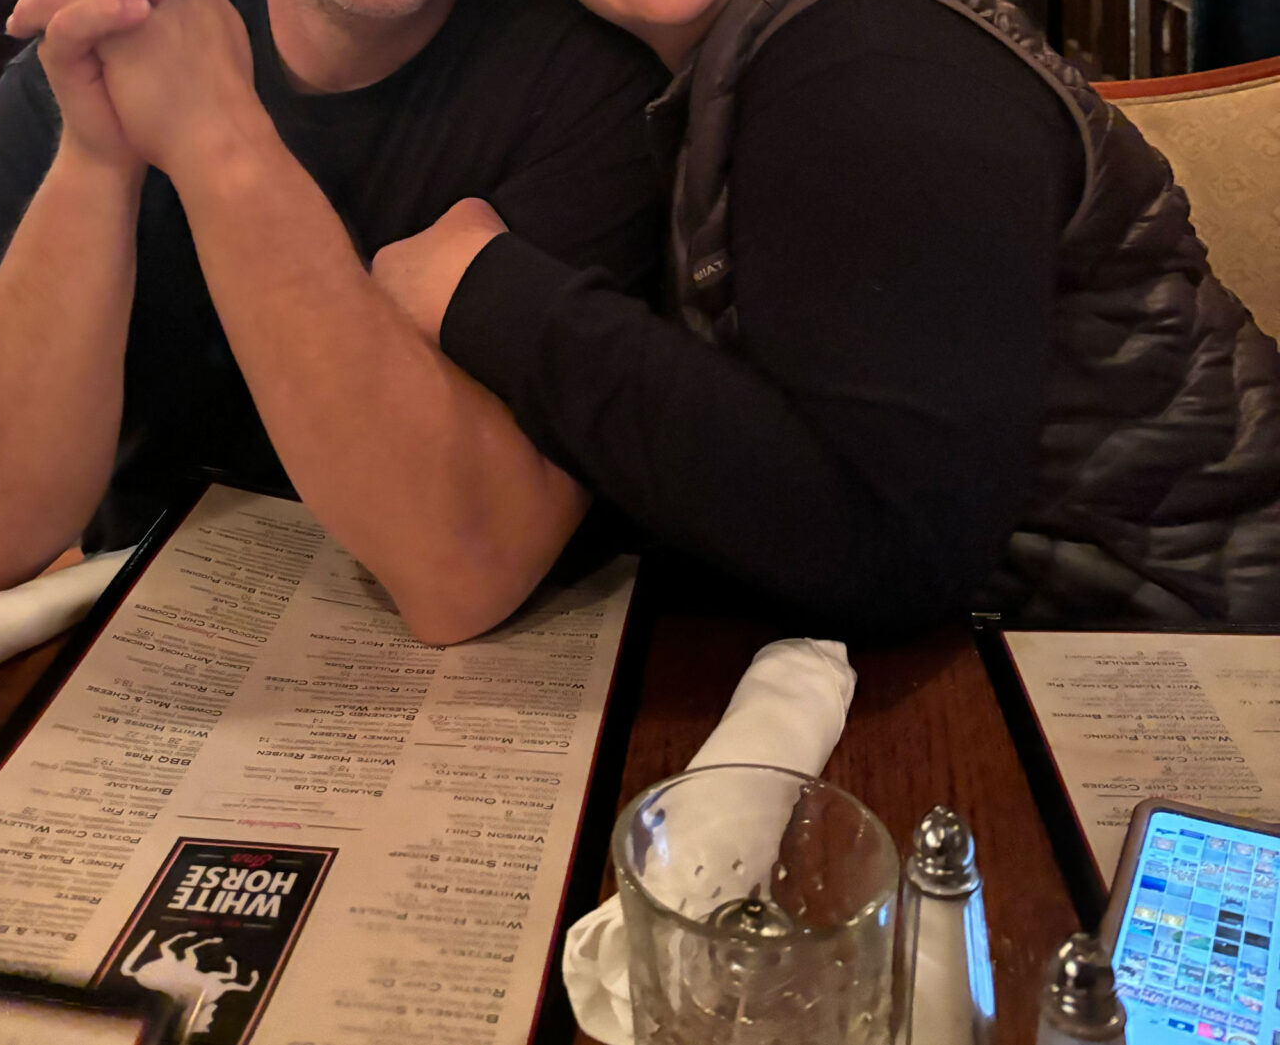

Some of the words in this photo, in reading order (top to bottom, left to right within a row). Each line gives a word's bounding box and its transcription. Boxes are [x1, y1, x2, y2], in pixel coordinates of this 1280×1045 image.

[179, 568, 221, 584] PUDDING
[223, 580, 256, 595] BREAD
[211, 596, 239, 608] CAKE
[259, 590, 290, 603] WARM
[133, 603, 177, 619] COOKIES
[241, 605, 281, 620] CARROT
[180, 615, 205, 627] CHIP
[209, 622, 267, 643] CHOCOLATE
[112, 634, 156, 650] CHICKEN
[310, 633, 357, 645] CHICKEN
[363, 640, 384, 648] HOT
[157, 646, 212, 665] ARTICHOKE
[214, 660, 250, 672] LEMON
[324, 662, 354, 670] PORK
[357, 664, 400, 674] PULLED
[264, 675, 308, 686] CHEESE
[442, 675, 493, 684] CHICKEN
[548, 680, 585, 690] WARM
[170, 680, 208, 693] ROAST
[312, 681, 358, 690] GRILLED
[362, 684, 400, 693] ROAST
[85, 684, 130, 701] CHEESE
[211, 686, 235, 697] POT
[133, 695, 142, 703] &
[145, 698, 171, 709] MAC
[173, 704, 223, 717] COWBOY
[294, 707, 344, 717] CHICKEN
[333, 703, 369, 711] WRAP
[374, 705, 419, 714] CAESAR
[91, 713, 119, 724] MAC
[349, 711, 416, 721] BLACKENED
[517, 710, 577, 720] ORCHARD
[123, 719, 165, 732] HORSE
[169, 726, 209, 739] WHITE
[309, 731, 357, 740] REUBEN
[1083, 733, 1139, 741] PUDDING
[1143, 734, 1186, 742] BREAD
[361, 734, 405, 743] TURKEY
[460, 734, 514, 744] MAURICE
[520, 738, 570, 748] CLASSIC
[1191, 734, 1233, 743] WARM
[124, 751, 153, 761] RIBS
[256, 749, 305, 760] REUBEN
[310, 753, 351, 764] HORSE
[1153, 755, 1188, 763] CAKE
[157, 755, 192, 766] BBQ
[357, 757, 395, 766] WHITE
[435, 768, 487, 780] TOMATO
[515, 775, 561, 786] CREAM
[104, 781, 173, 796] BUFFALOAF
[293, 784, 327, 793] CLUB
[332, 787, 383, 798] SALMON
[1081, 782, 1140, 792] COOKIES
[1145, 783, 1178, 792] CHIP
[453, 795, 496, 805] ONION
[501, 798, 554, 810] FRENCH
[98, 805, 125, 816] FRY
[129, 808, 158, 819] FISH
[55, 826, 87, 838] CHIP
[91, 831, 142, 844] POTATO
[444, 828, 481, 839] CHILI
[486, 831, 545, 844] VENISON
[38, 852, 75, 865] PLUM
[78, 857, 126, 871] HONEY
[230, 853, 273, 868] Inn
[446, 855, 496, 868] STREET
[503, 861, 538, 872] HIGH
[179, 865, 299, 894] HORSE
[413, 882, 449, 894] PATE
[454, 886, 531, 901] WHITEFISH
[53, 892, 102, 905] RIBEYE
[166, 886, 282, 918] WHITE
[474, 918, 523, 930] WHITE
[34, 929, 78, 942] BLACK
